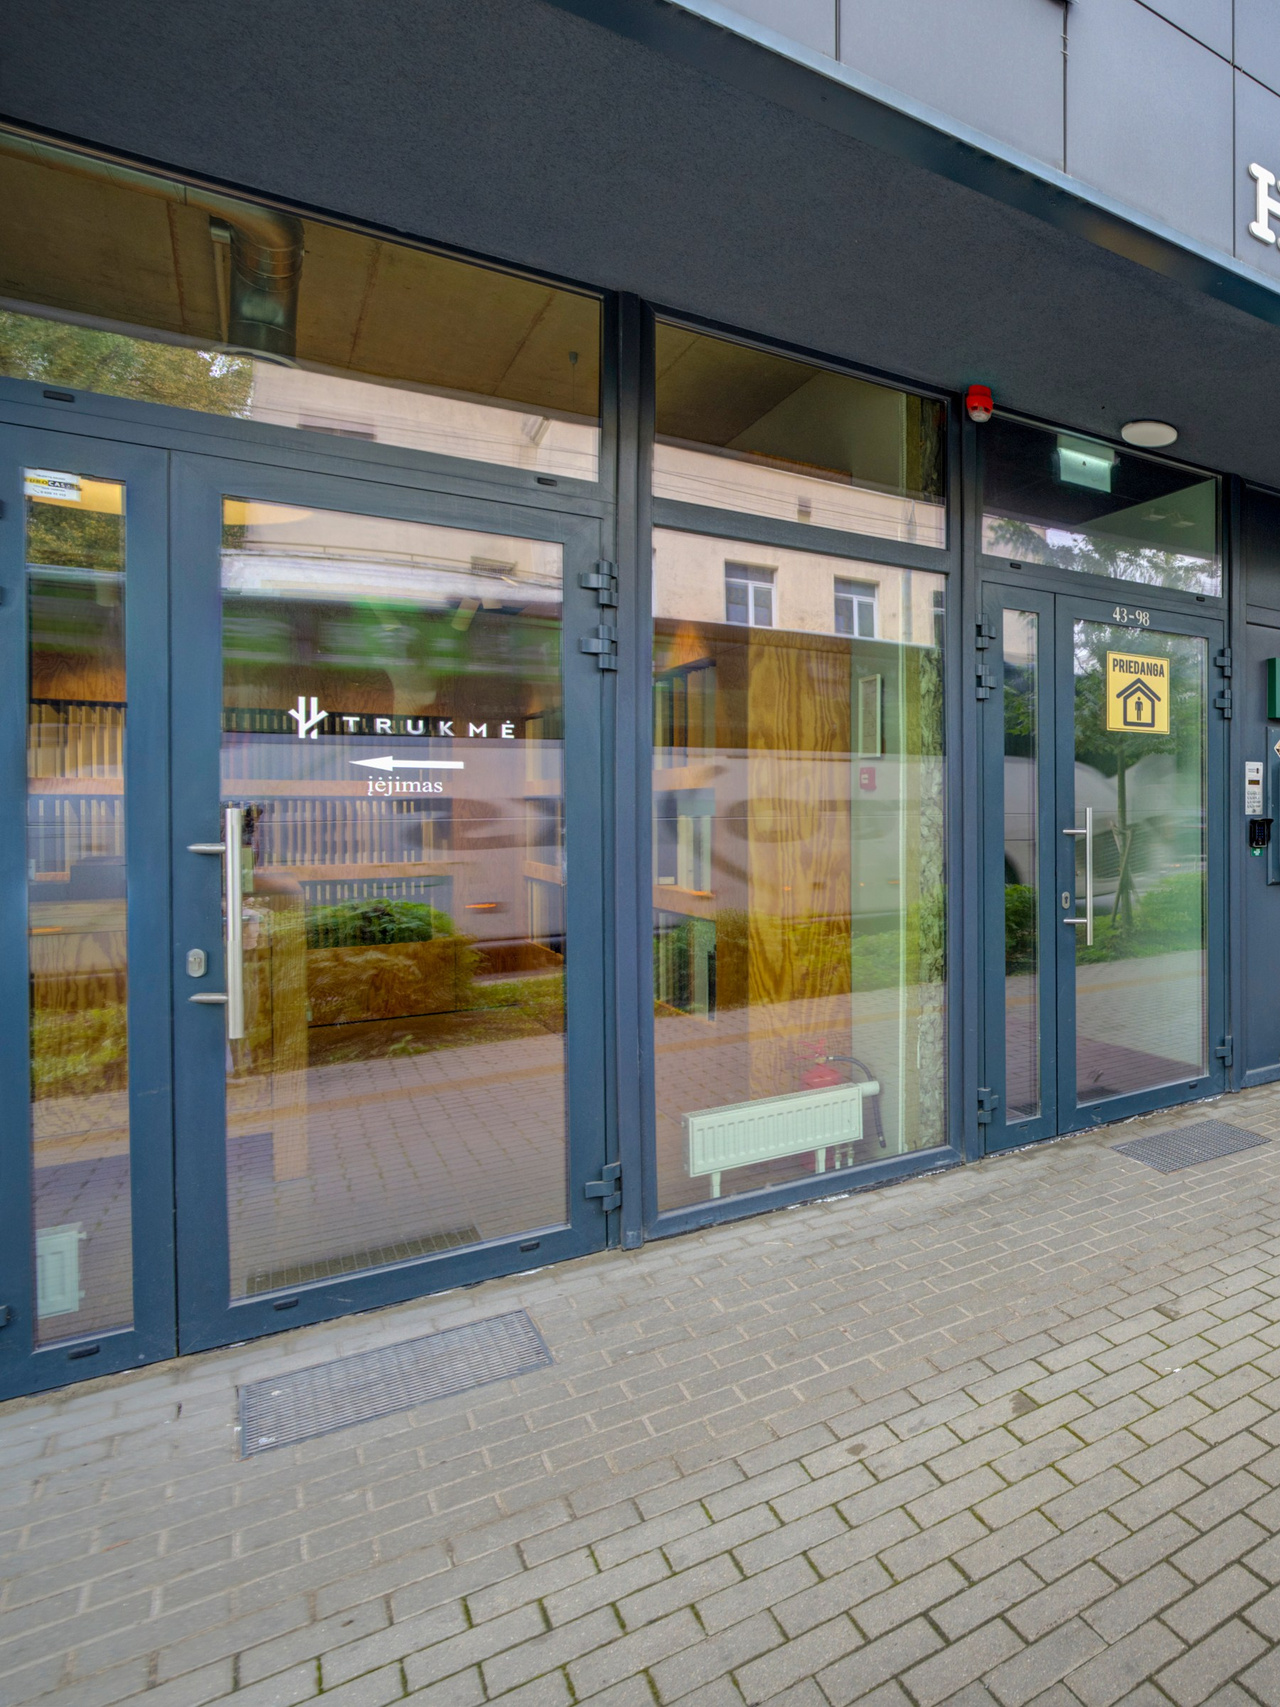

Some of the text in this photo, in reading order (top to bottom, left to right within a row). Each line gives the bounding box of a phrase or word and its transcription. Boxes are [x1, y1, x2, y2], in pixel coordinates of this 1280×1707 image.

[1112, 606, 1150, 626] 43-98
[1112, 658, 1165, 678] PRIEDANGA
[342, 716, 515, 739] TRUKMĖ
[366, 776, 443, 796] įėjimas
